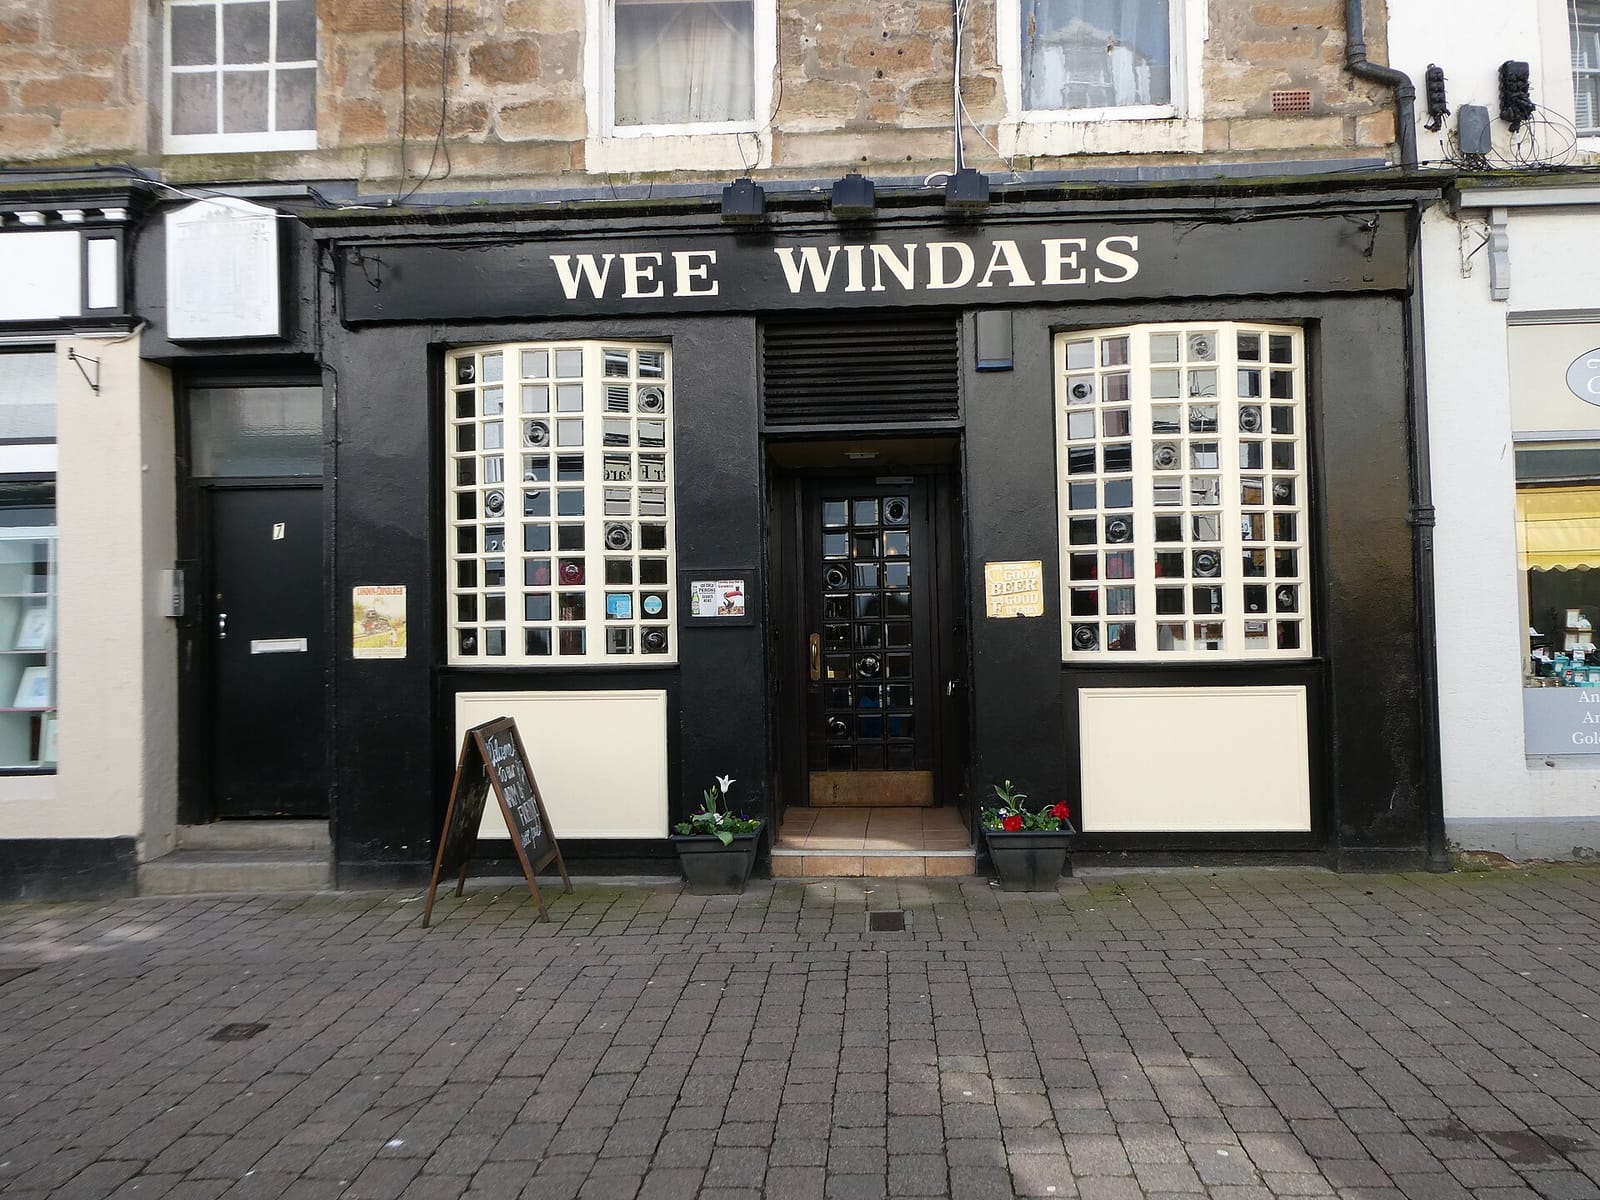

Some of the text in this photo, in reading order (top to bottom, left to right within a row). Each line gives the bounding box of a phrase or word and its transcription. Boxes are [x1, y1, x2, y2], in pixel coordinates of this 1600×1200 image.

[549, 235, 1140, 300] WEE WINDAES
[991, 579, 1039, 595] BEER
